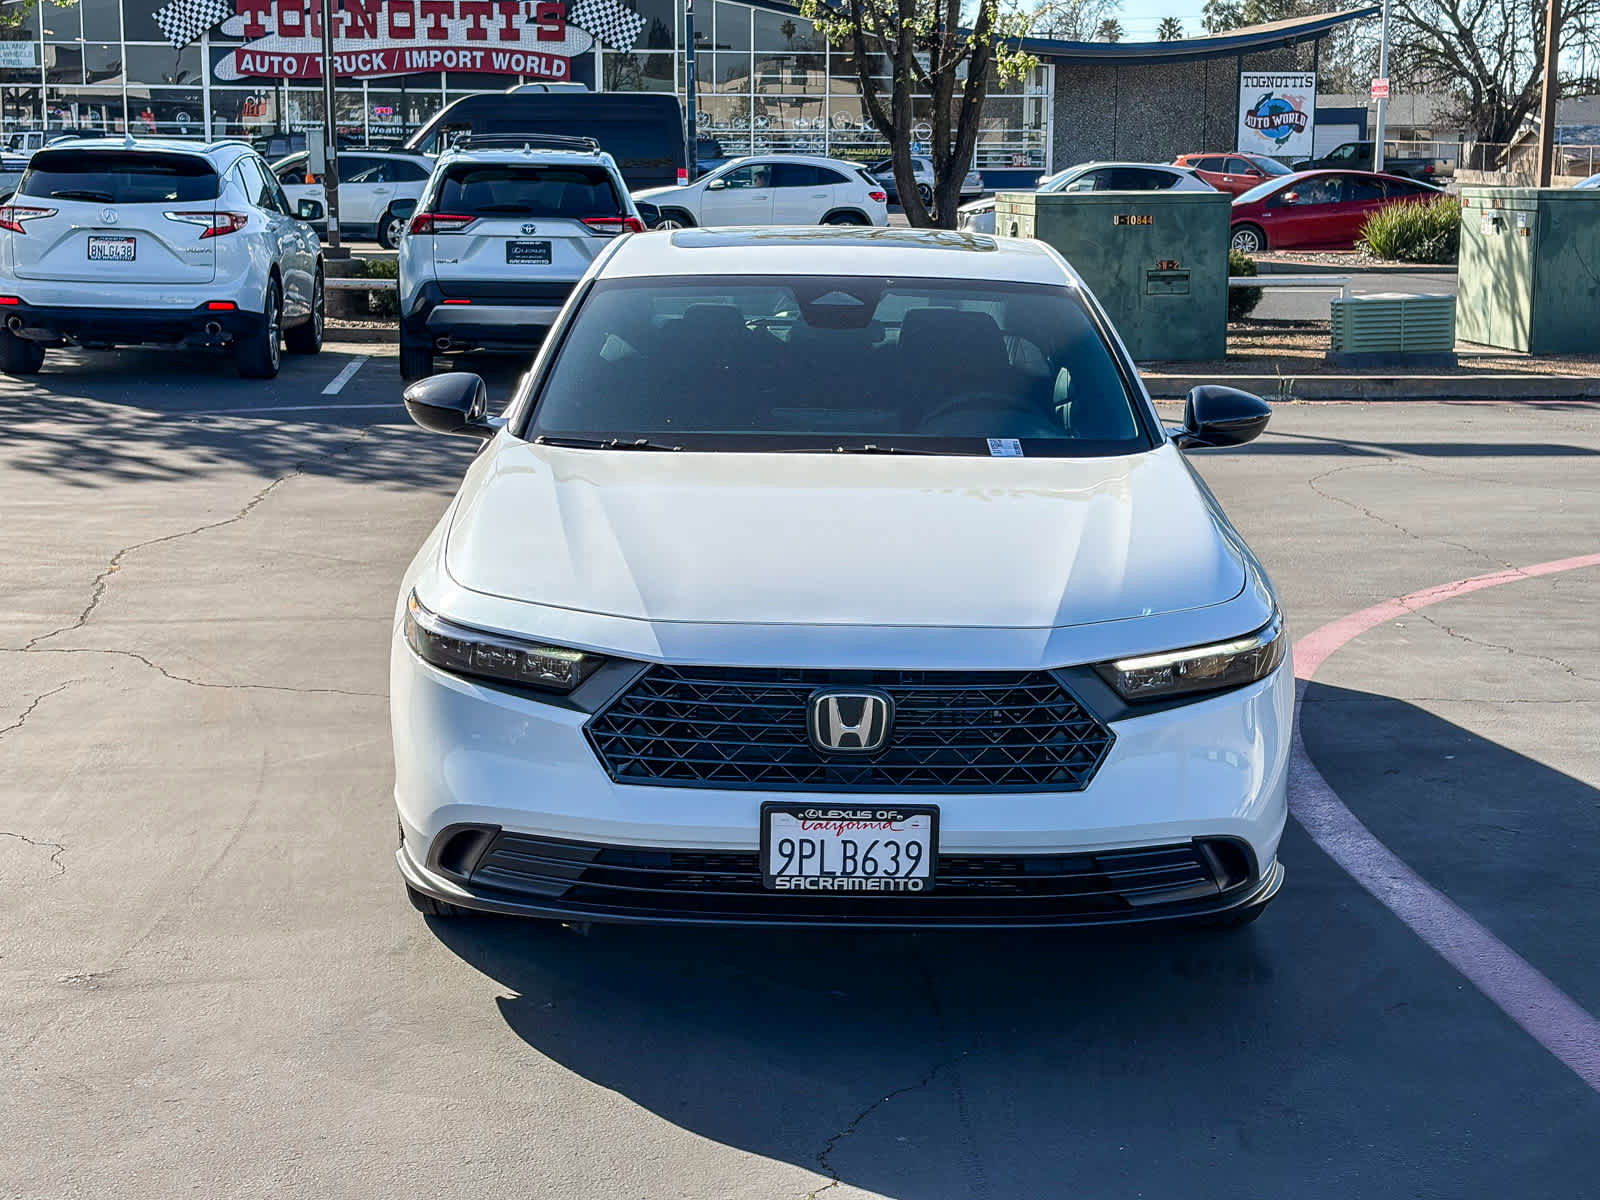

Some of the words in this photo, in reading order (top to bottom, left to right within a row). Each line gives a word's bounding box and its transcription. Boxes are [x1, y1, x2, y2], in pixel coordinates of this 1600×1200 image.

[240, 53, 298, 75] AUTO
[405, 50, 485, 69] IMPORT
[492, 51, 567, 78] WORLD
[1243, 74, 1314, 88] TOGNOTTI'S
[1247, 115, 1271, 129] AUTO
[1271, 112, 1306, 127] WORLD
[818, 811, 872, 820] LEXUS
[876, 811, 899, 820] OF
[777, 838, 923, 878] 9PLB639
[775, 876, 924, 892] SACRAMENTO
